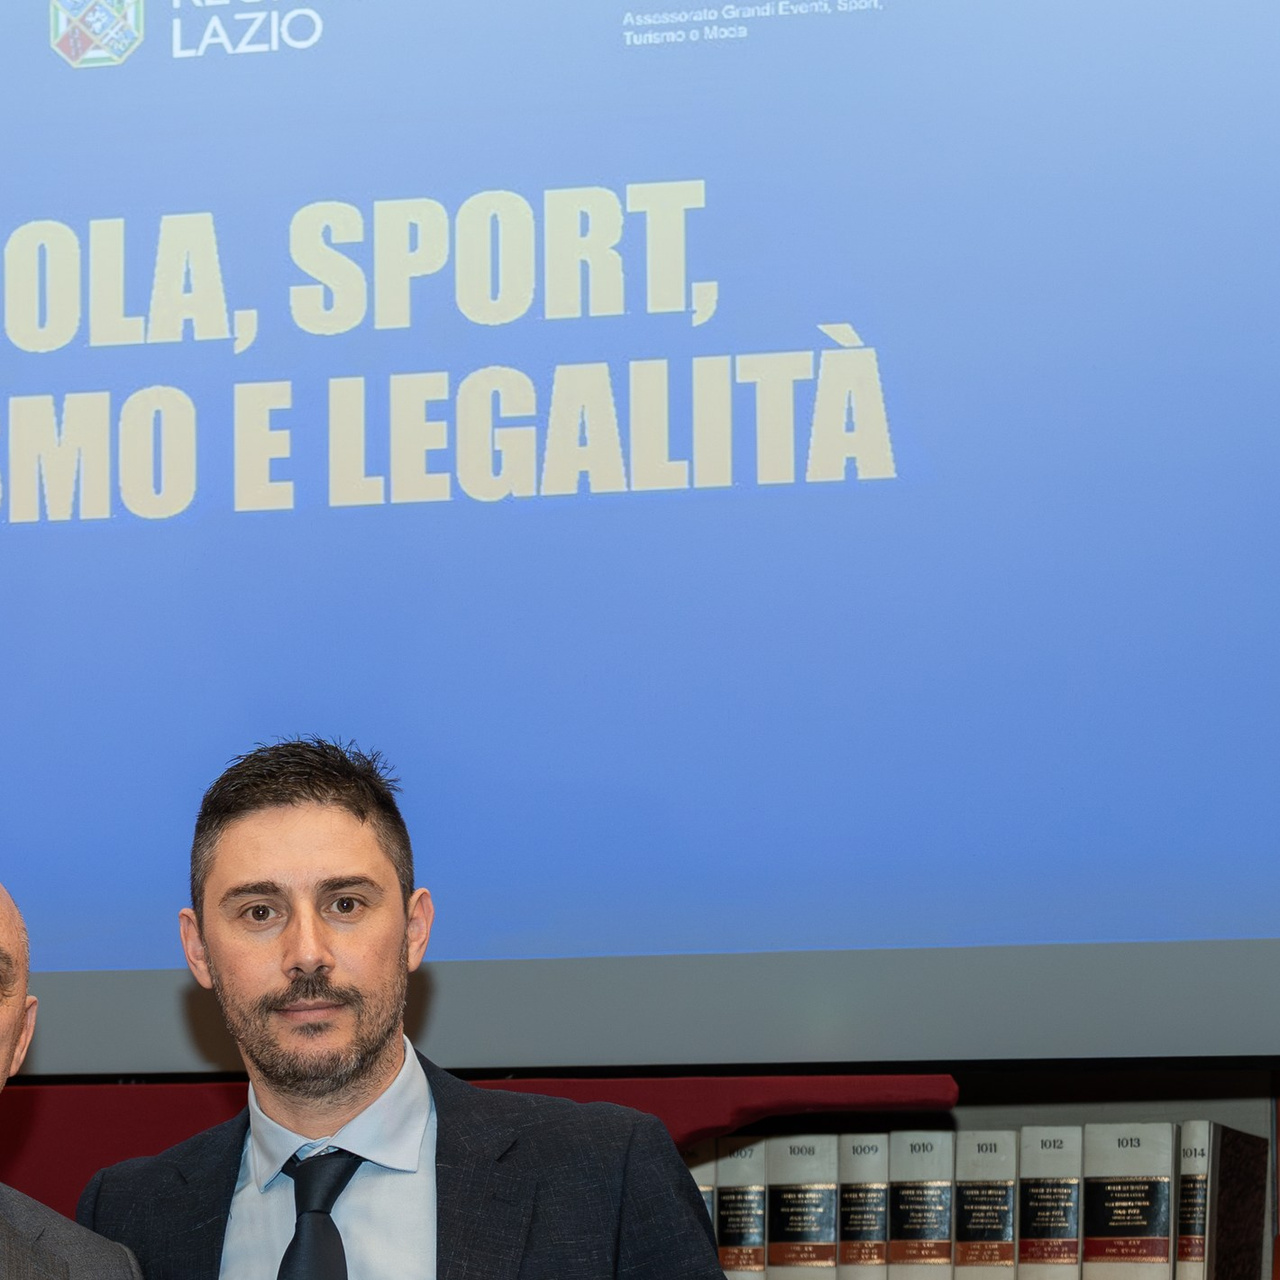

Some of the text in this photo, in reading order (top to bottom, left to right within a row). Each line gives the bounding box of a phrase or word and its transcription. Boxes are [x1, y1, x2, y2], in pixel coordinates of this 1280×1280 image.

[172, 8, 324, 58] LAZIO
[290, 180, 718, 335] SPORT,
[234, 381, 294, 511] E
[328, 322, 897, 507] LEGALITÀ
[909, 1142, 934, 1155] 1010
[976, 1142, 997, 1154] 1011
[1040, 1138, 1064, 1150] 1012
[1117, 1137, 1141, 1149] 1013
[788, 1144, 815, 1156] 1008
[851, 1144, 879, 1156] 1009
[1182, 1147, 1207, 1159] 1014
